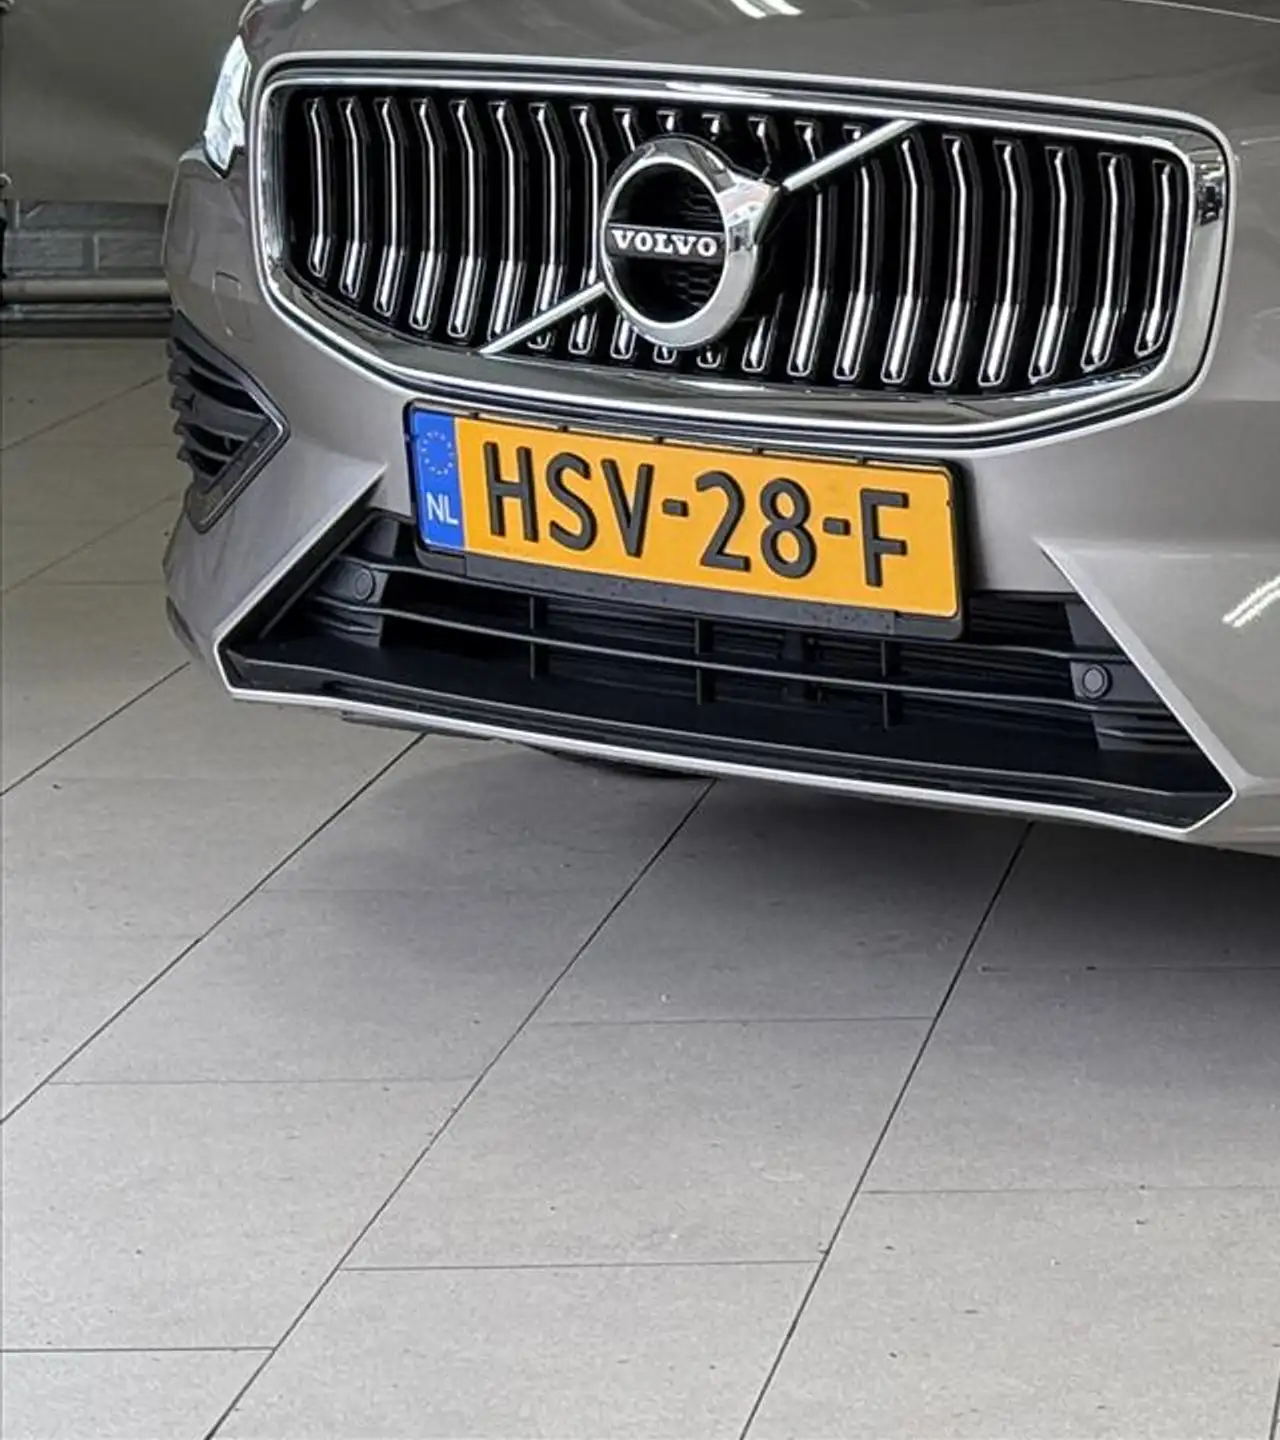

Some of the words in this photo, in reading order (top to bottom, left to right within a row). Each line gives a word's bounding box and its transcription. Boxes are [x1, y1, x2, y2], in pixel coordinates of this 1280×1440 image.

[610, 228, 718, 258] VOLVO
[426, 490, 460, 526] NL
[482, 440, 911, 590] HSV-28-F
